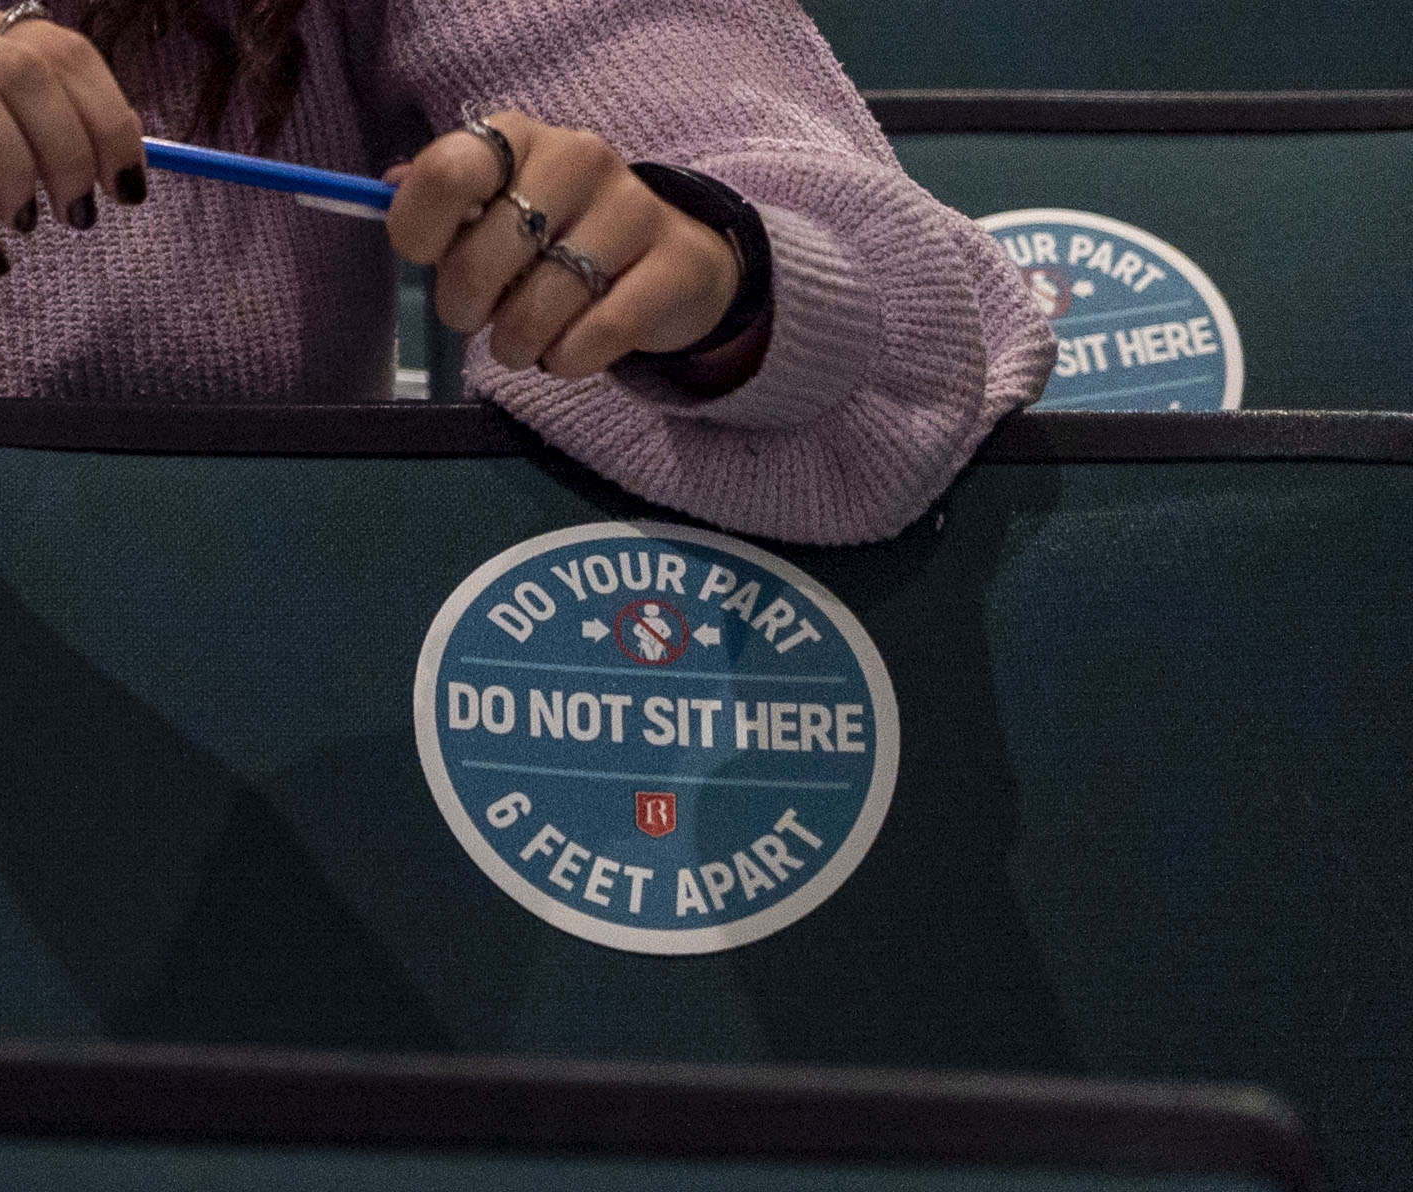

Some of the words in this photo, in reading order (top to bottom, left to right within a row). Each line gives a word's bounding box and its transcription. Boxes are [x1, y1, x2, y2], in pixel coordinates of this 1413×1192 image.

[1004, 232, 1057, 267] UR
[1069, 235, 1166, 293] PART
[1054, 333, 1109, 378] SIT
[1115, 316, 1218, 368] HERE
[487, 581, 556, 644] DO
[551, 551, 687, 601] YOUR
[699, 566, 822, 655] PART
[448, 681, 515, 735] DO
[529, 690, 632, 743] NOT
[642, 696, 722, 748] SIT
[734, 702, 866, 753] HERE
[485, 791, 532, 830] 6
[519, 823, 654, 914] FEET
[675, 808, 825, 917] APART
